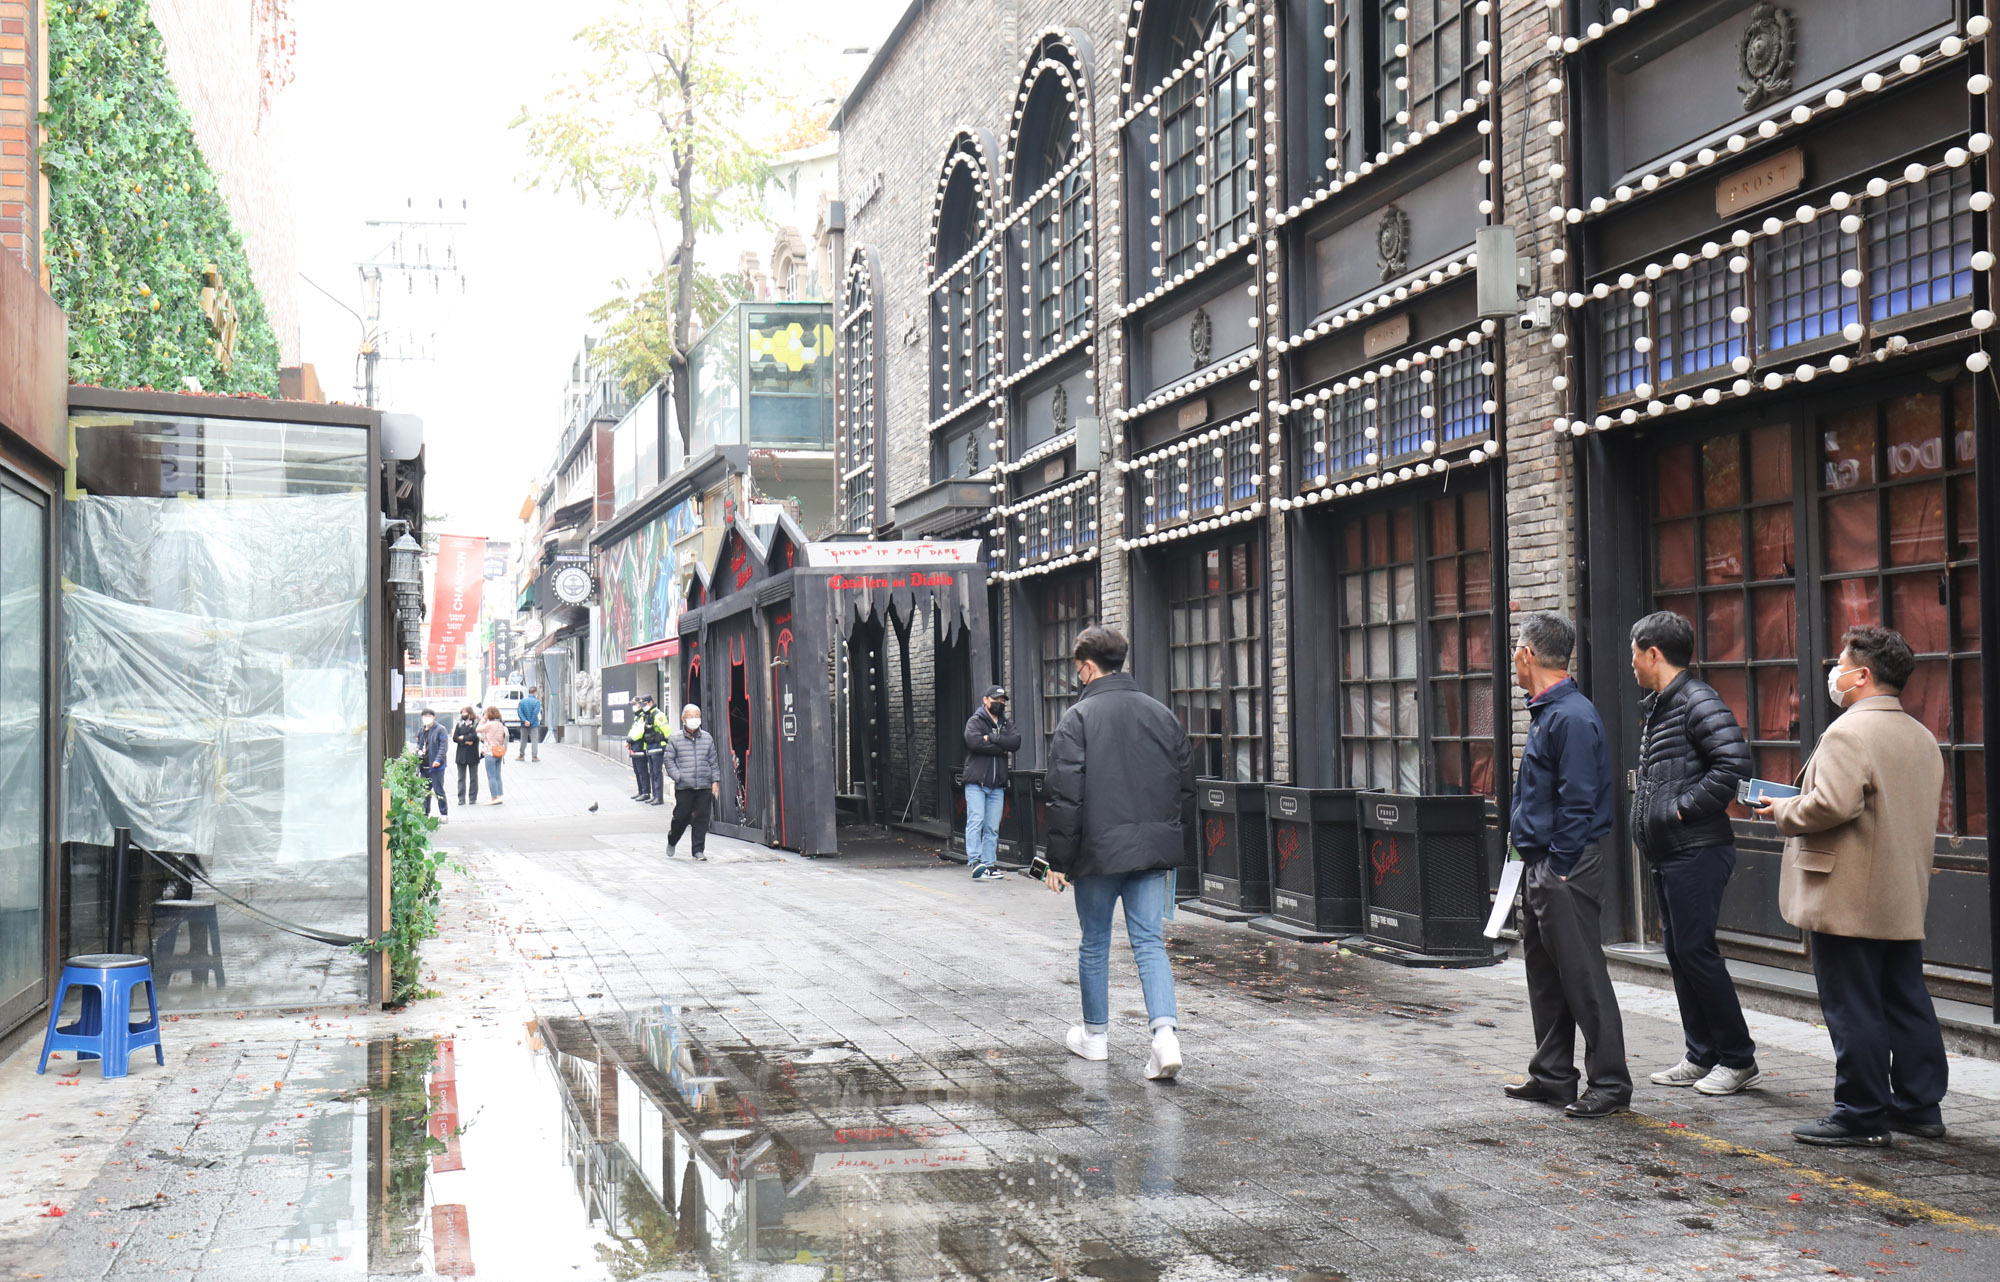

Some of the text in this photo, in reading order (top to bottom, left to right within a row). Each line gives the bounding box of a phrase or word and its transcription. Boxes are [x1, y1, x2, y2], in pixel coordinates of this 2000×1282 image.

[1730, 165, 1787, 202] PROST
[453, 551, 467, 611] CHANDON
[829, 572, 954, 590] Casillero del Diablo
[1380, 809, 1395, 817] PROST
